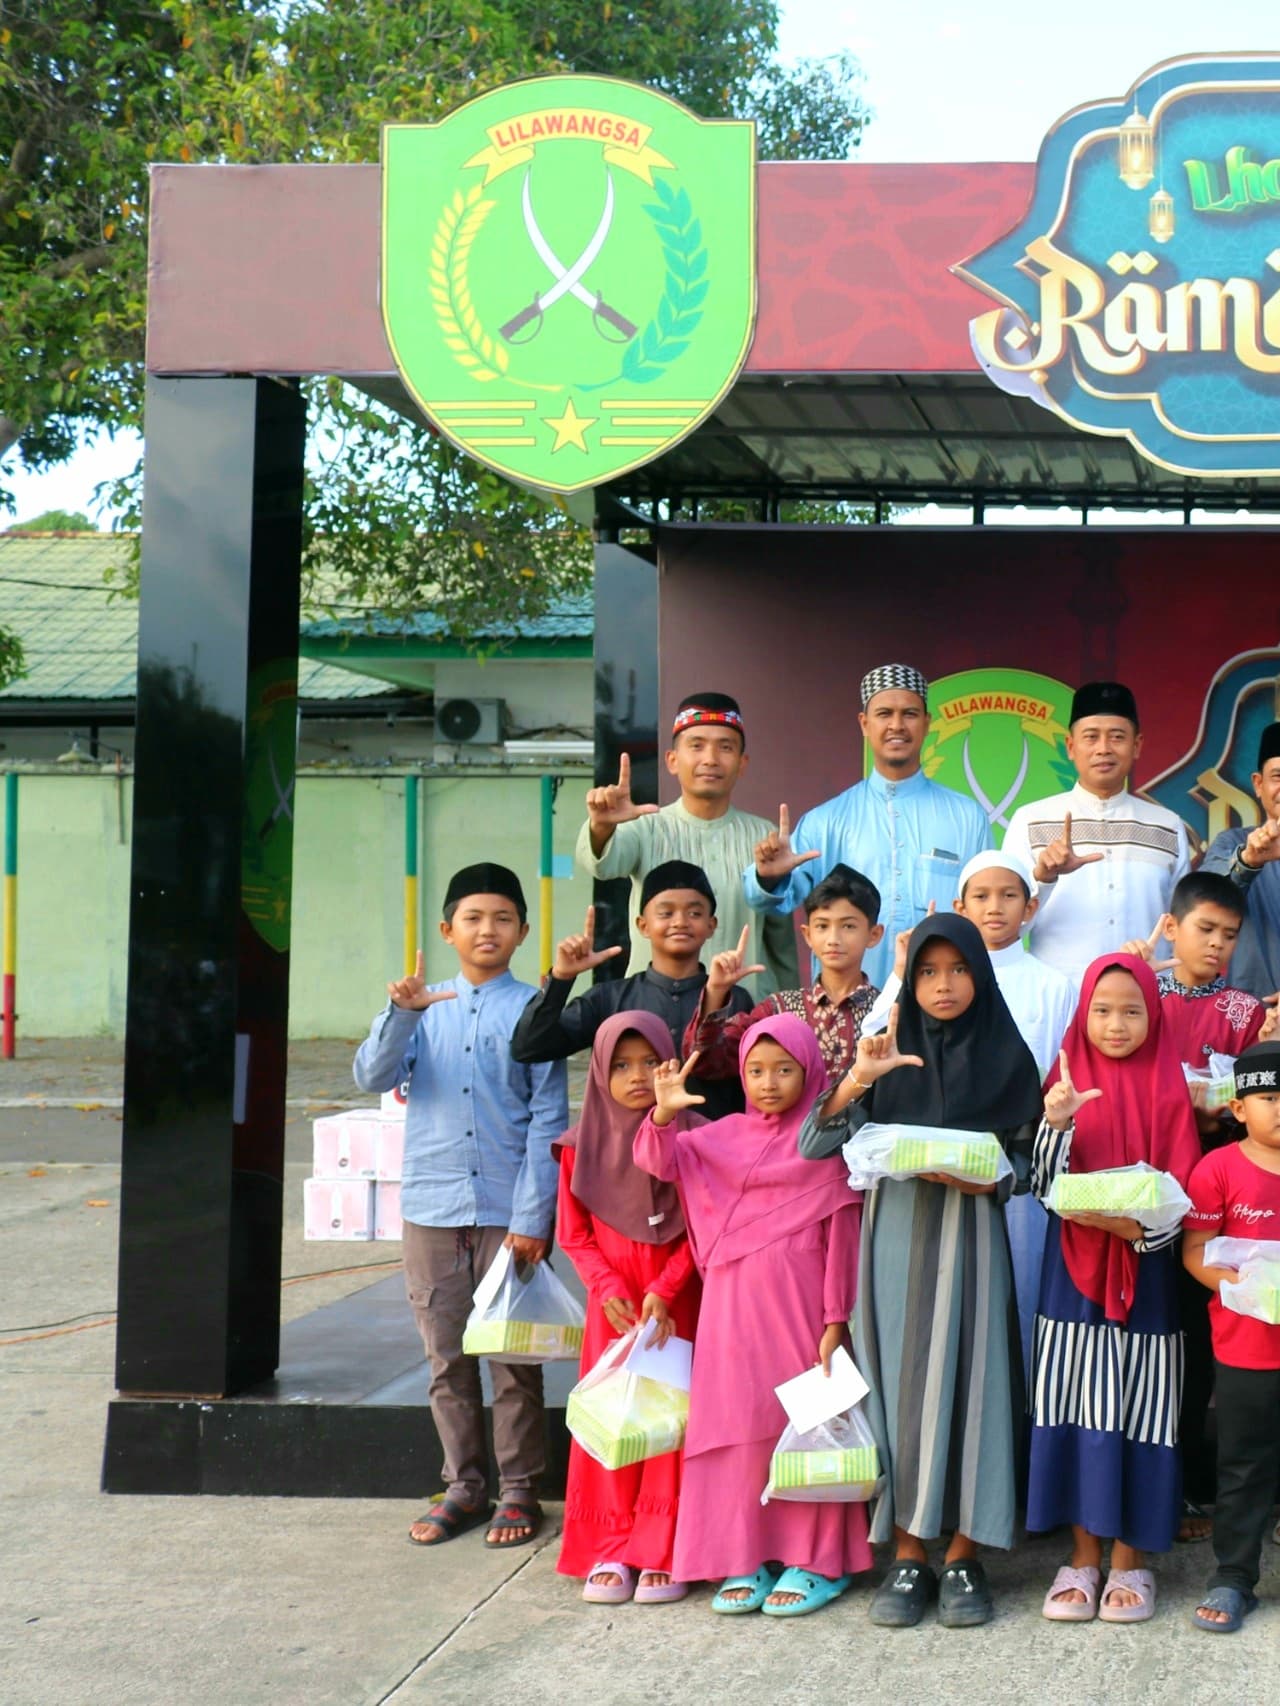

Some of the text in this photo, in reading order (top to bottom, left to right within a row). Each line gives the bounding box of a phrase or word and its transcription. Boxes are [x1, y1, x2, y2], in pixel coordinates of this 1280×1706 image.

[495, 114, 641, 148] LILAWANGSA
[944, 696, 1048, 720] LILAWANGSA
[1232, 1203, 1275, 1224] Hugo
